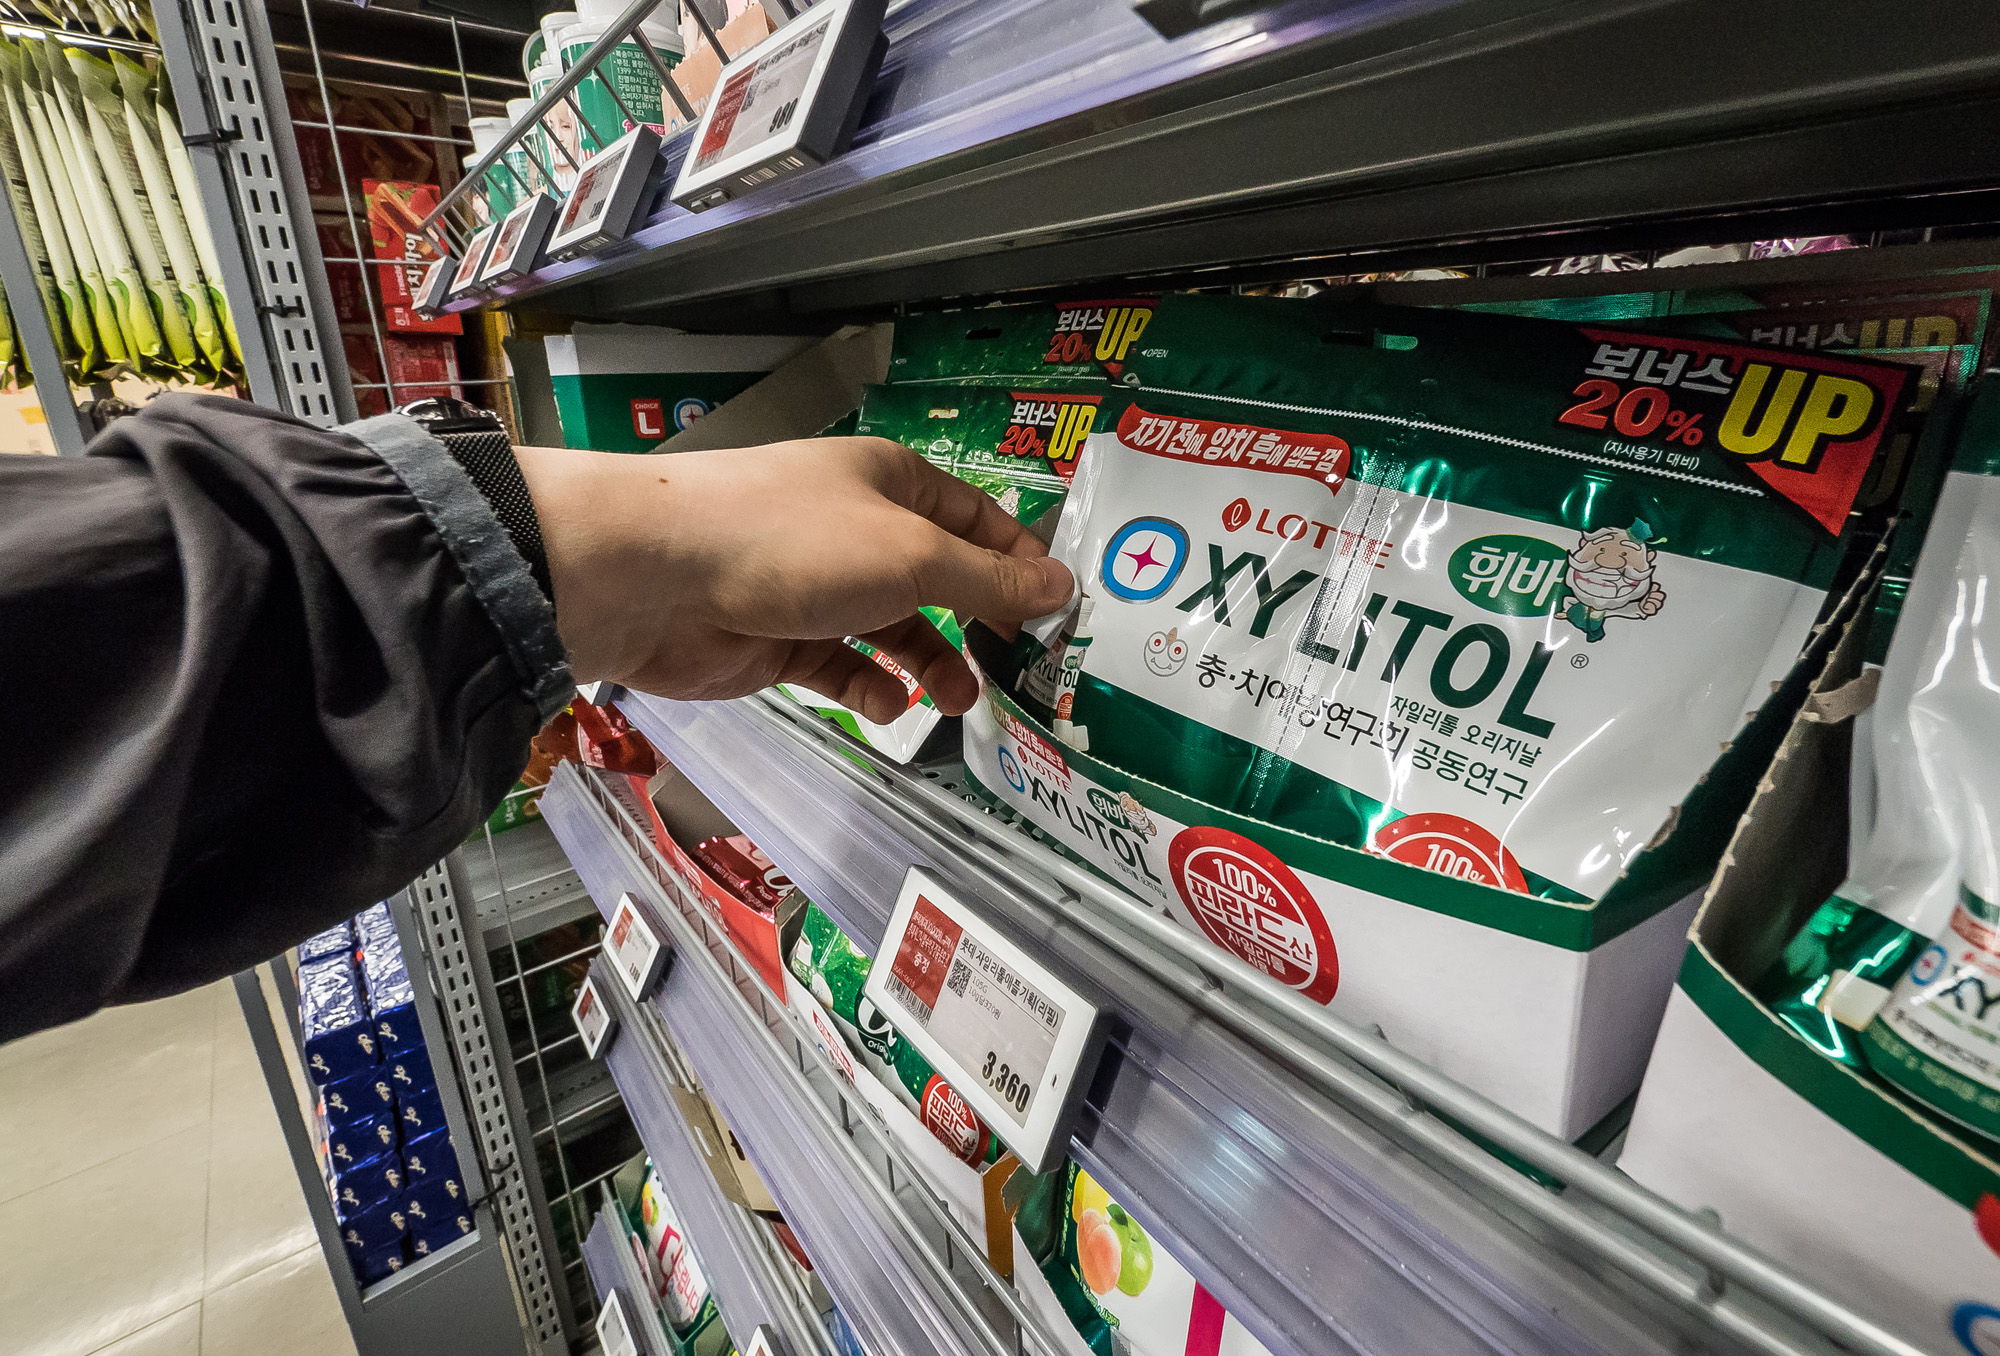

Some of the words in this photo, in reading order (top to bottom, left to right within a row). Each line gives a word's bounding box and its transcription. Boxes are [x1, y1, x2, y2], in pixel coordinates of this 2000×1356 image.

[768, 97, 799, 133] 980
[1044, 333, 1093, 363] 20%
[1055, 309, 1105, 332] 보너스
[1095, 307, 1152, 361] UP
[1147, 349, 1169, 358] OPEN
[1010, 401, 1057, 427] 보너스
[1048, 404, 1097, 460] UP
[1558, 379, 1704, 446] 20%
[1585, 344, 1735, 395] 보너스
[1718, 363, 1875, 465] UP
[998, 426, 1045, 456] 20%
[1125, 416, 1173, 450] 자기
[1208, 430, 1250, 461] 양치
[1247, 434, 1287, 468] 후에
[1284, 443, 1320, 472] 씹는
[1317, 445, 1342, 475] 껌
[1602, 438, 1664, 464] (자사용기
[1666, 448, 1701, 471] 대비)
[1257, 509, 1394, 570] LOTTE
[1465, 545, 1567, 609] 휘바
[1176, 542, 1558, 740] XYLITOL
[1389, 696, 1460, 738] 자일리톨
[1461, 721, 1544, 768] 오리지날
[1028, 758, 1072, 795] LOTTE
[1410, 738, 1532, 805] 공동연구
[1022, 767, 1162, 885] XYLITOL
[1212, 858, 1277, 907] 100%
[1189, 874, 1314, 966] 핀란드산
[912, 952, 931, 973] 증정
[959, 936, 976, 961] 롯데
[1225, 928, 1287, 976] 자일리톨
[972, 975, 989, 995] 105G
[947, 1087, 968, 1120] 100%
[981, 1051, 1031, 1113] 3,360
